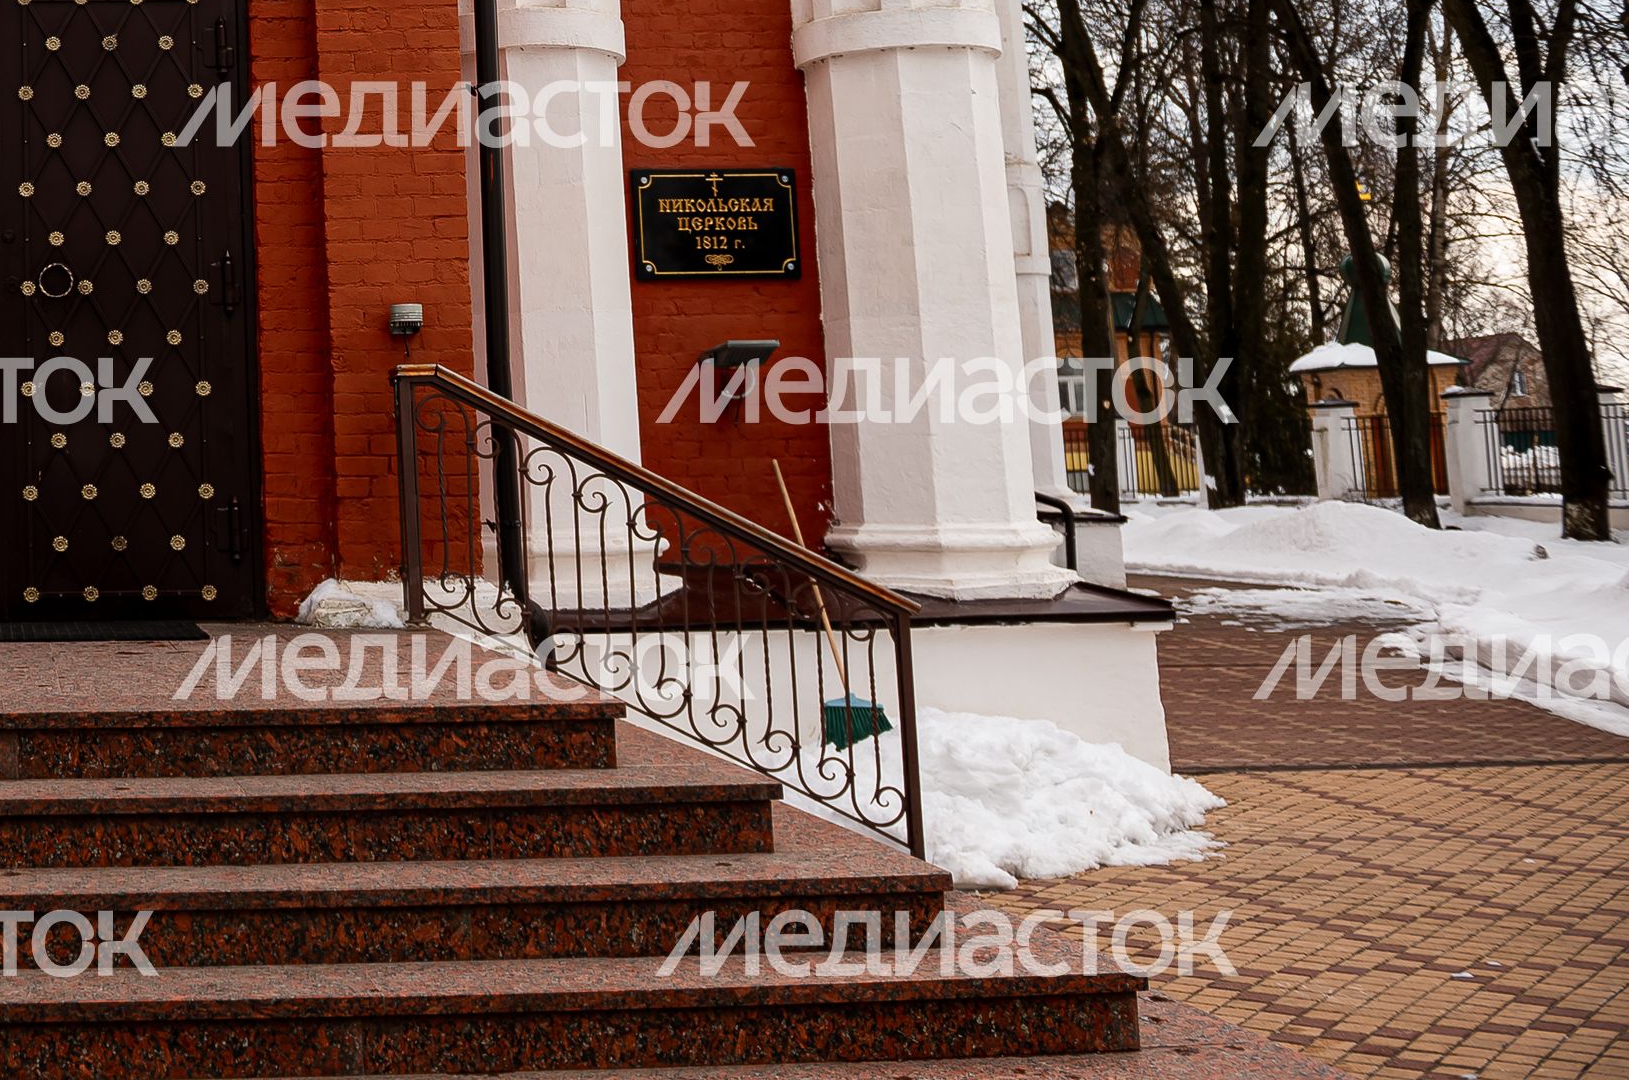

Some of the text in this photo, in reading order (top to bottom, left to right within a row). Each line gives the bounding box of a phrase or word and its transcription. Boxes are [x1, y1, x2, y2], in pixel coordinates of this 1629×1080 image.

[658, 197, 775, 213] НИКОЛЬСКАЯ
[677, 216, 759, 234] ЦЕРКОВЬ
[695, 236, 746, 250] 1812 г.
